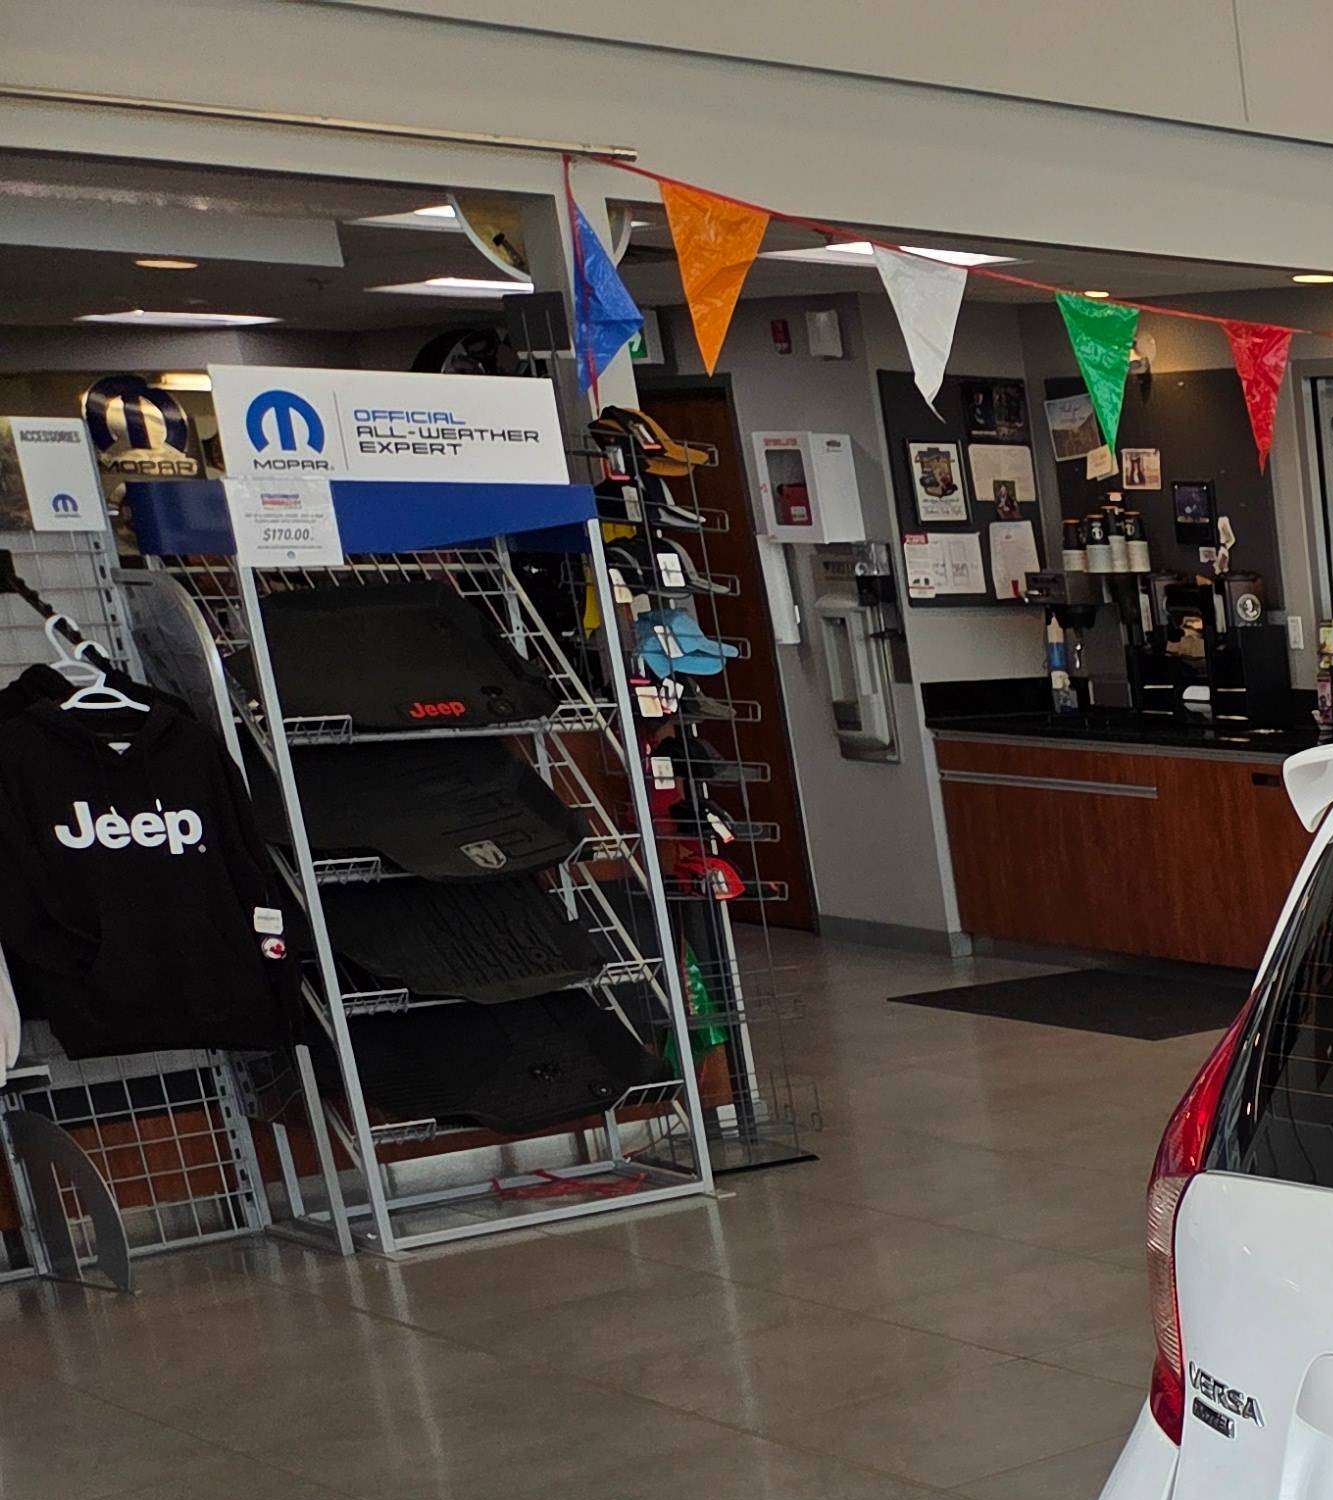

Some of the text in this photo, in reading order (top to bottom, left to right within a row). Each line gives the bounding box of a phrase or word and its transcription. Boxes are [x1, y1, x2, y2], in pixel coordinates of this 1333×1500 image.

[354, 409, 466, 425] OFFICIAL
[357, 426, 540, 443] ALL-WEATHER
[360, 441, 463, 456] EXPERT
[99, 460, 196, 476] MOPAR
[253, 459, 329, 471] MOPAR
[410, 701, 466, 718] Jeep
[54, 801, 203, 855] Jeep
[1189, 1360, 1265, 1429] VERSA
